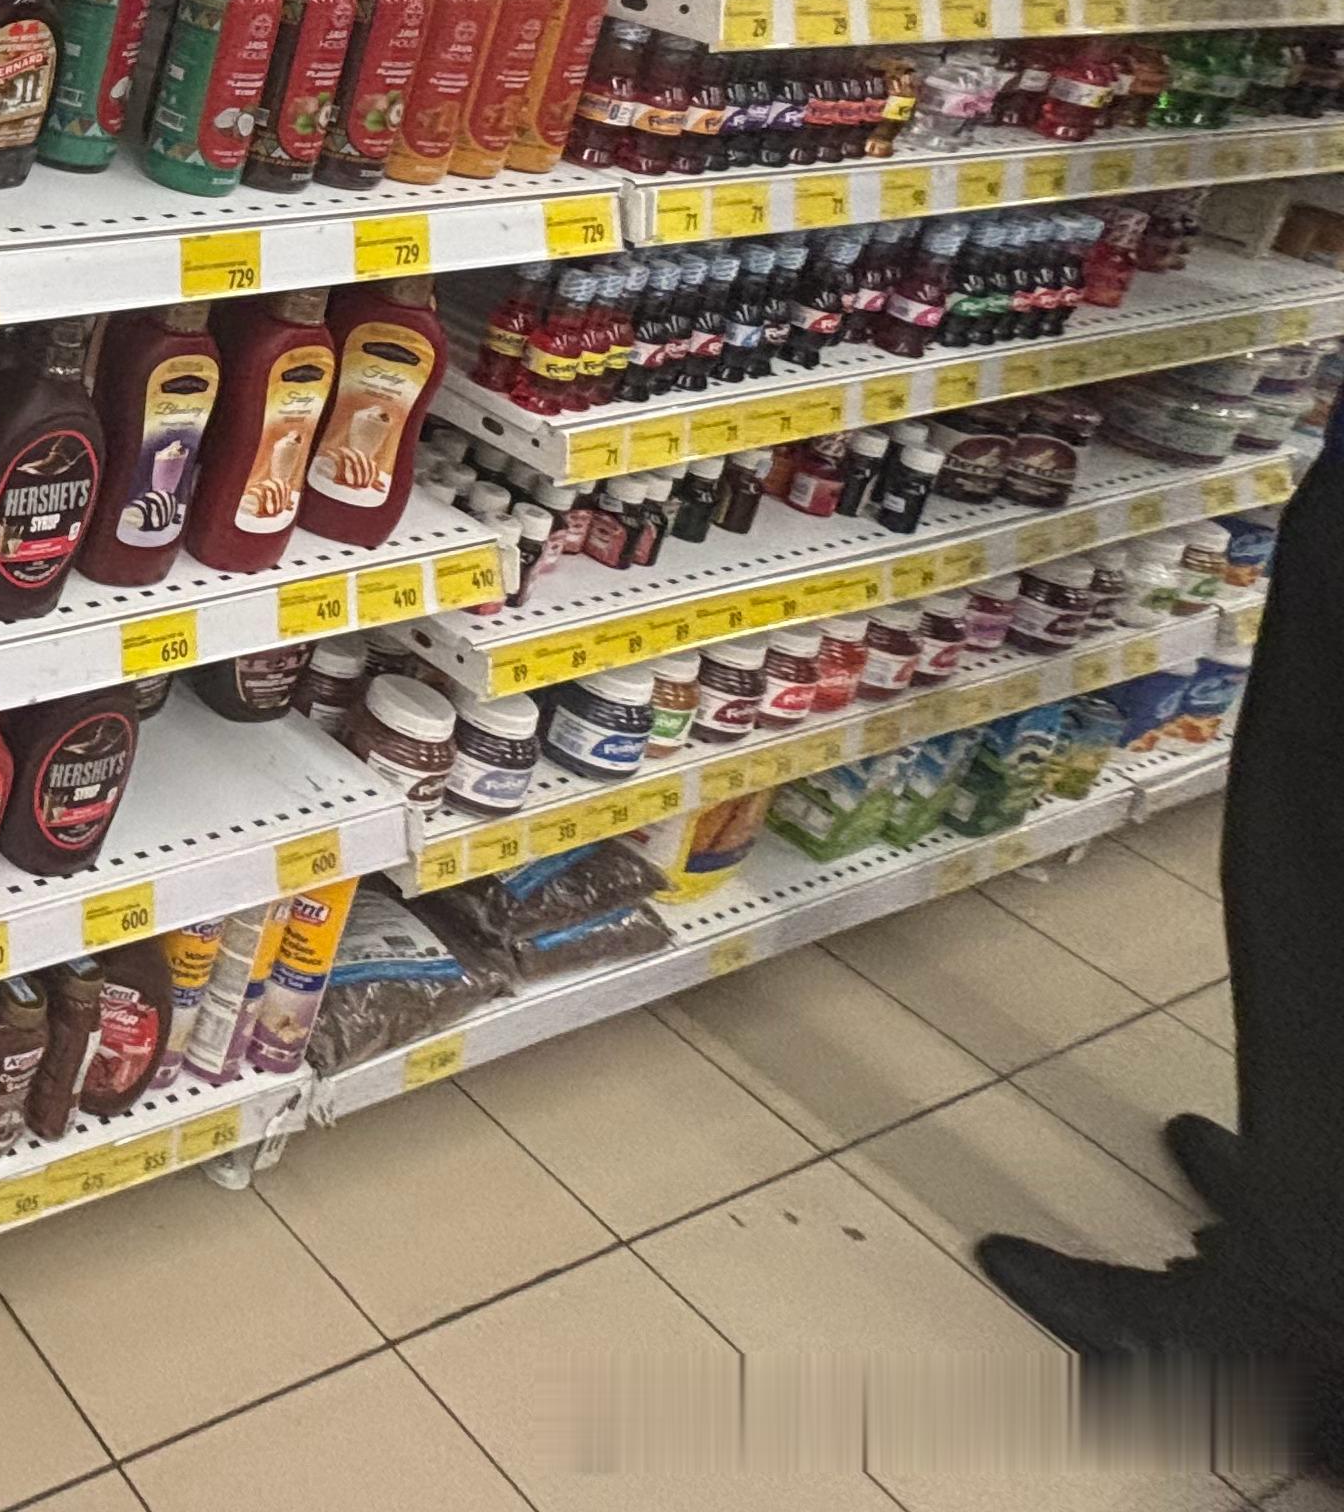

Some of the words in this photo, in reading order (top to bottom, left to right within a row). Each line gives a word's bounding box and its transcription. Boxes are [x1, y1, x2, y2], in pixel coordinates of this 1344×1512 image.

[582, 222, 604, 243] 729
[394, 244, 419, 265] 729
[227, 267, 254, 289] 729
[4, 478, 89, 516] HERSHEY'S
[29, 513, 59, 533] SYRUP
[472, 568, 494, 588] 410
[393, 588, 417, 608] 410
[316, 599, 341, 620] 410
[162, 641, 188, 662] 650
[50, 753, 126, 788] HERSHEY'S
[312, 851, 336, 872] 600
[121, 909, 149, 930] 600
